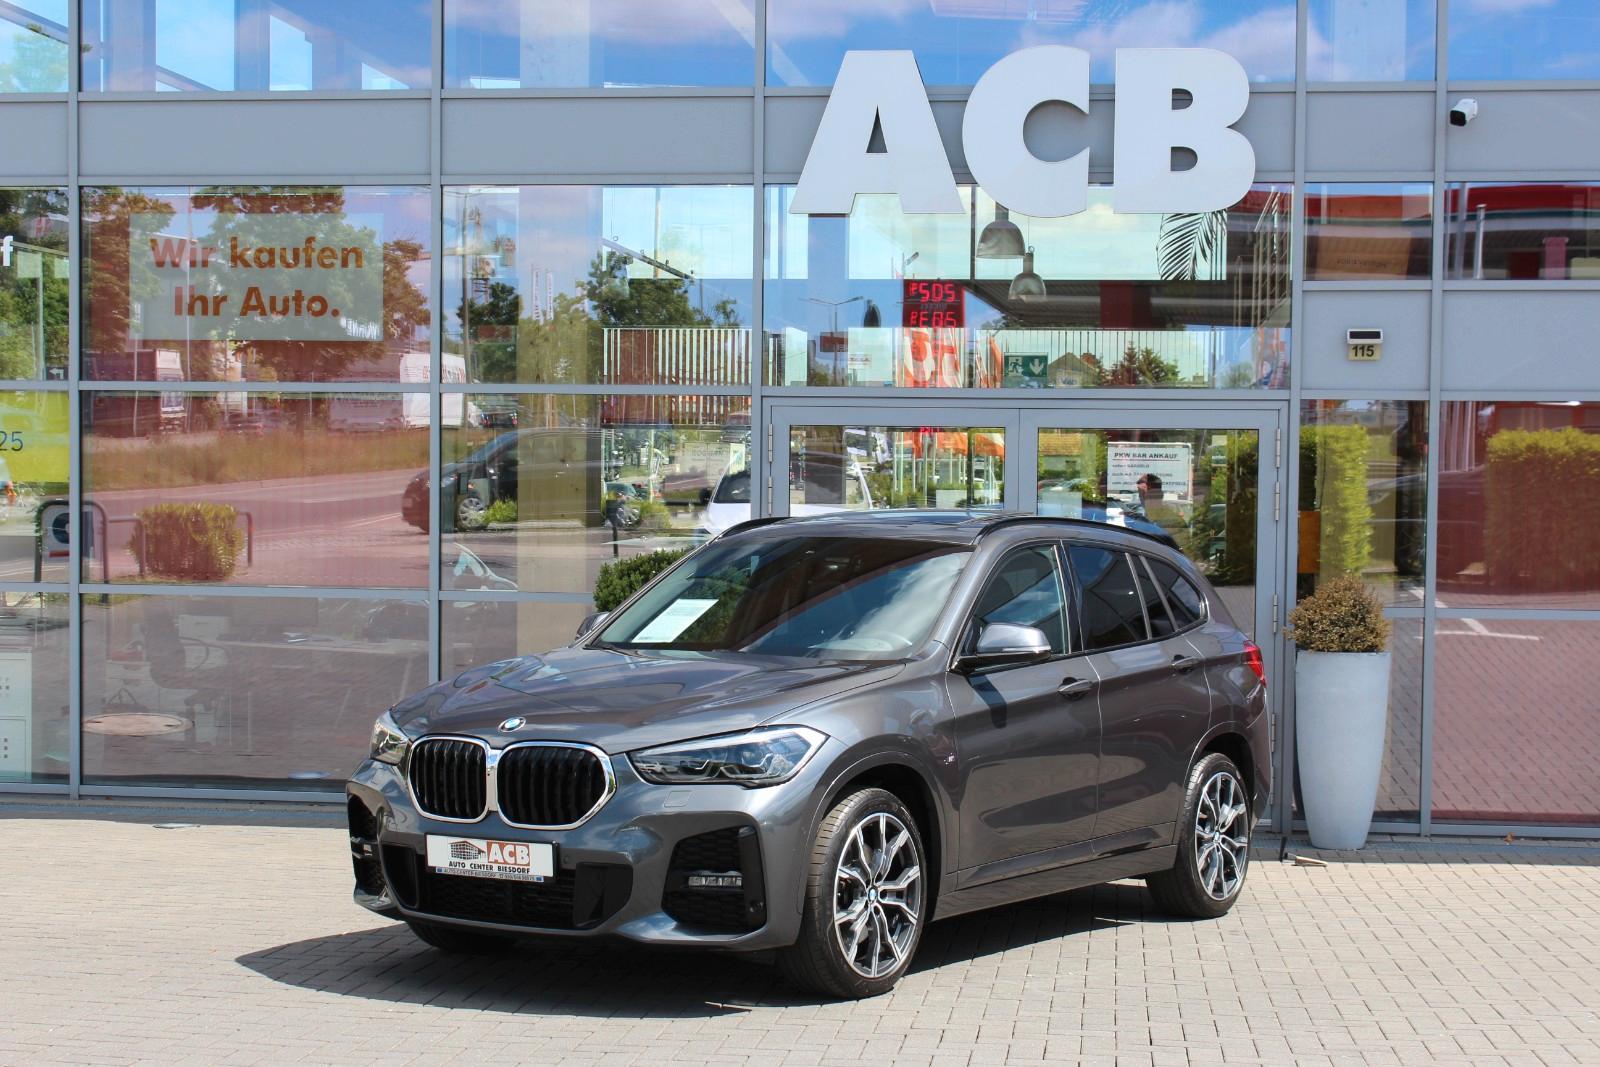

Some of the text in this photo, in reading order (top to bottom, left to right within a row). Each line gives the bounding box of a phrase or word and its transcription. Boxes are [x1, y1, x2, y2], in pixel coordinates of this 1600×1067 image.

[789, 45, 1255, 218] ACB
[150, 236, 363, 269] Wir kaufen
[174, 286, 341, 317] Ihr Auto.
[1352, 345, 1375, 357] 115
[448, 860, 530, 874] AUTO CENTER BIESDORF
[488, 843, 530, 865] ACB
